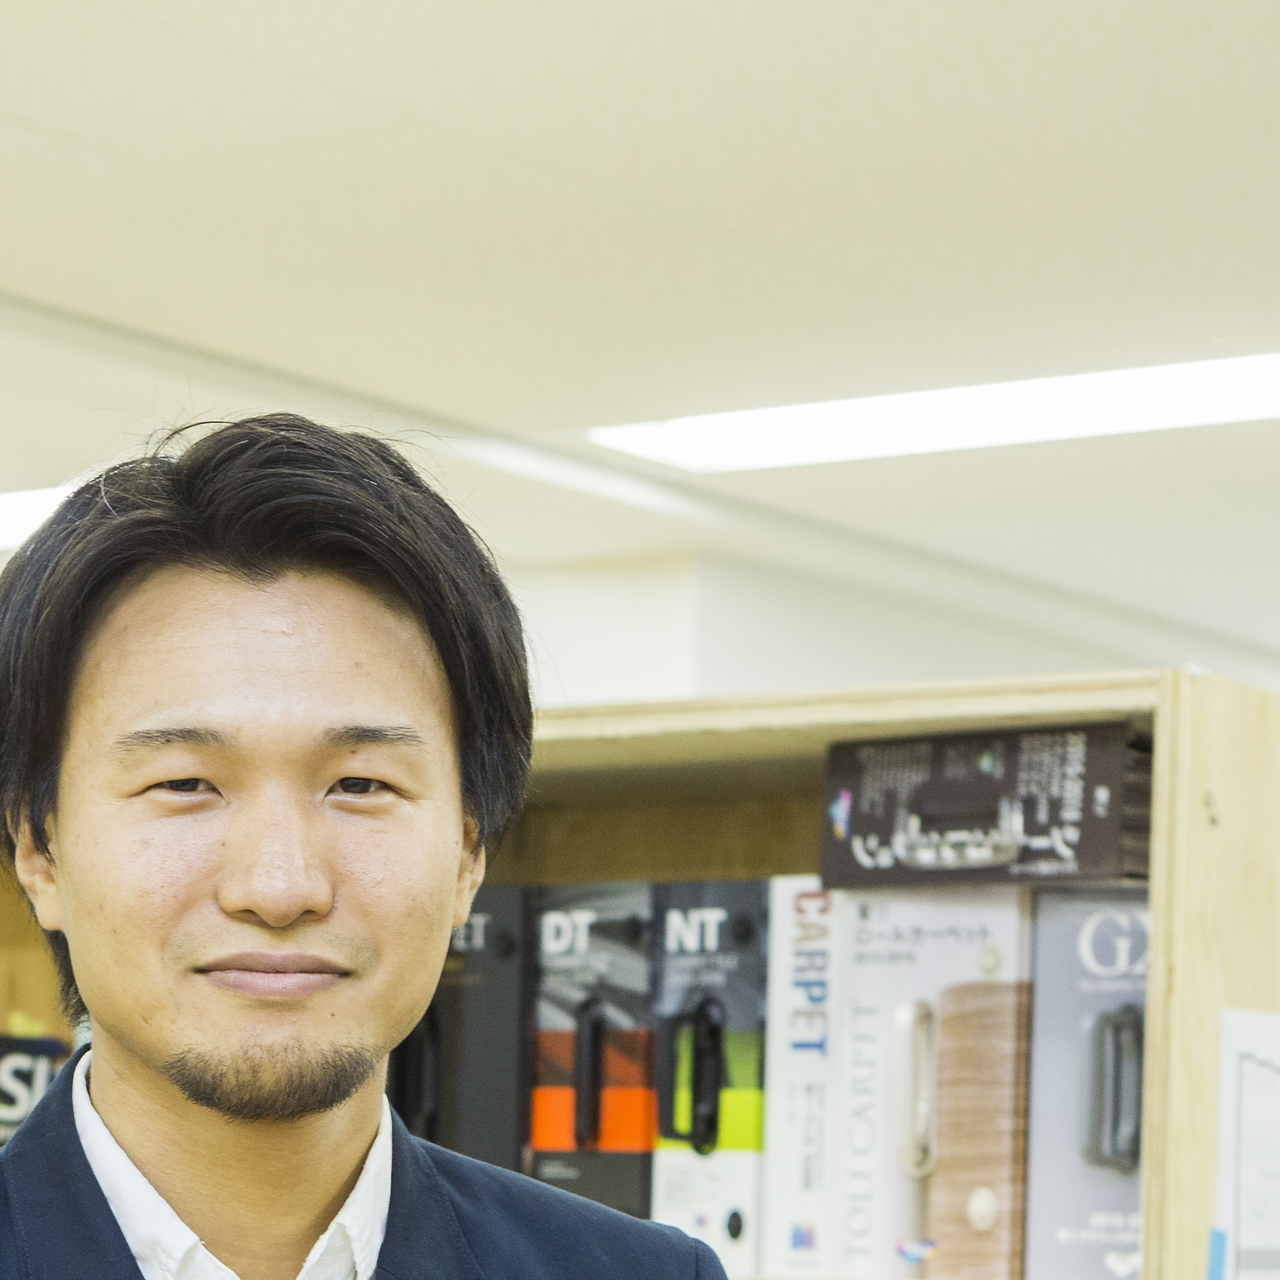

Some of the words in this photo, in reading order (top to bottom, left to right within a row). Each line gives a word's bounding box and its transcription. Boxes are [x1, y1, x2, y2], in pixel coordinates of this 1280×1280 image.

[540, 909, 595, 955] DT
[665, 907, 727, 952] NT
[790, 889, 833, 1061] CARPET
